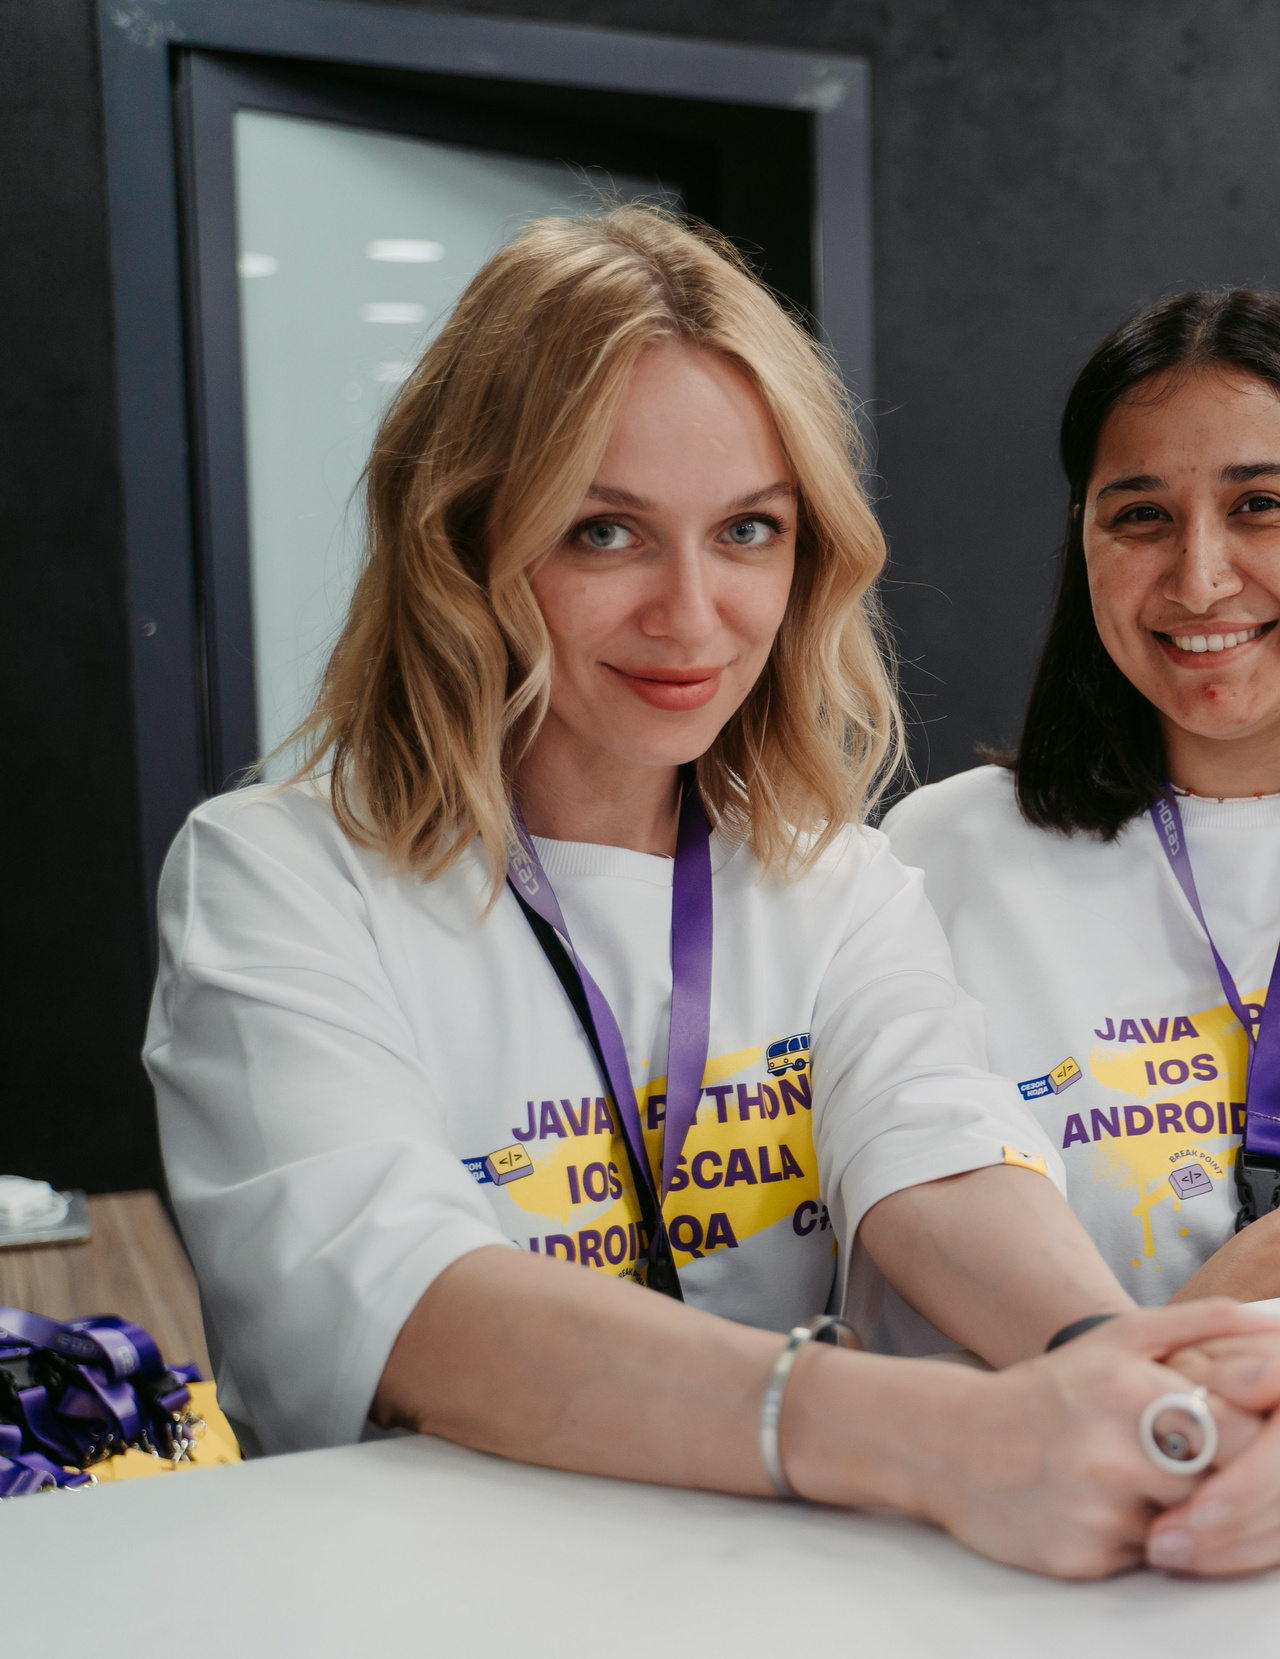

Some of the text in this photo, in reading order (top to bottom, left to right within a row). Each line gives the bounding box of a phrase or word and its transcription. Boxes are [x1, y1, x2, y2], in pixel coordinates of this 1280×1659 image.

[1094, 1016, 1200, 1044] JAVA
[1144, 1053, 1218, 1085] IOS
[1020, 1079, 1046, 1092] СЕЗОН
[1026, 1086, 1049, 1097] КОДА
[512, 1097, 615, 1142] JAVA
[1168, 1149, 1223, 1174] BREAK POINT
[567, 1161, 622, 1204] IOS
[668, 1214, 739, 1259] QA
